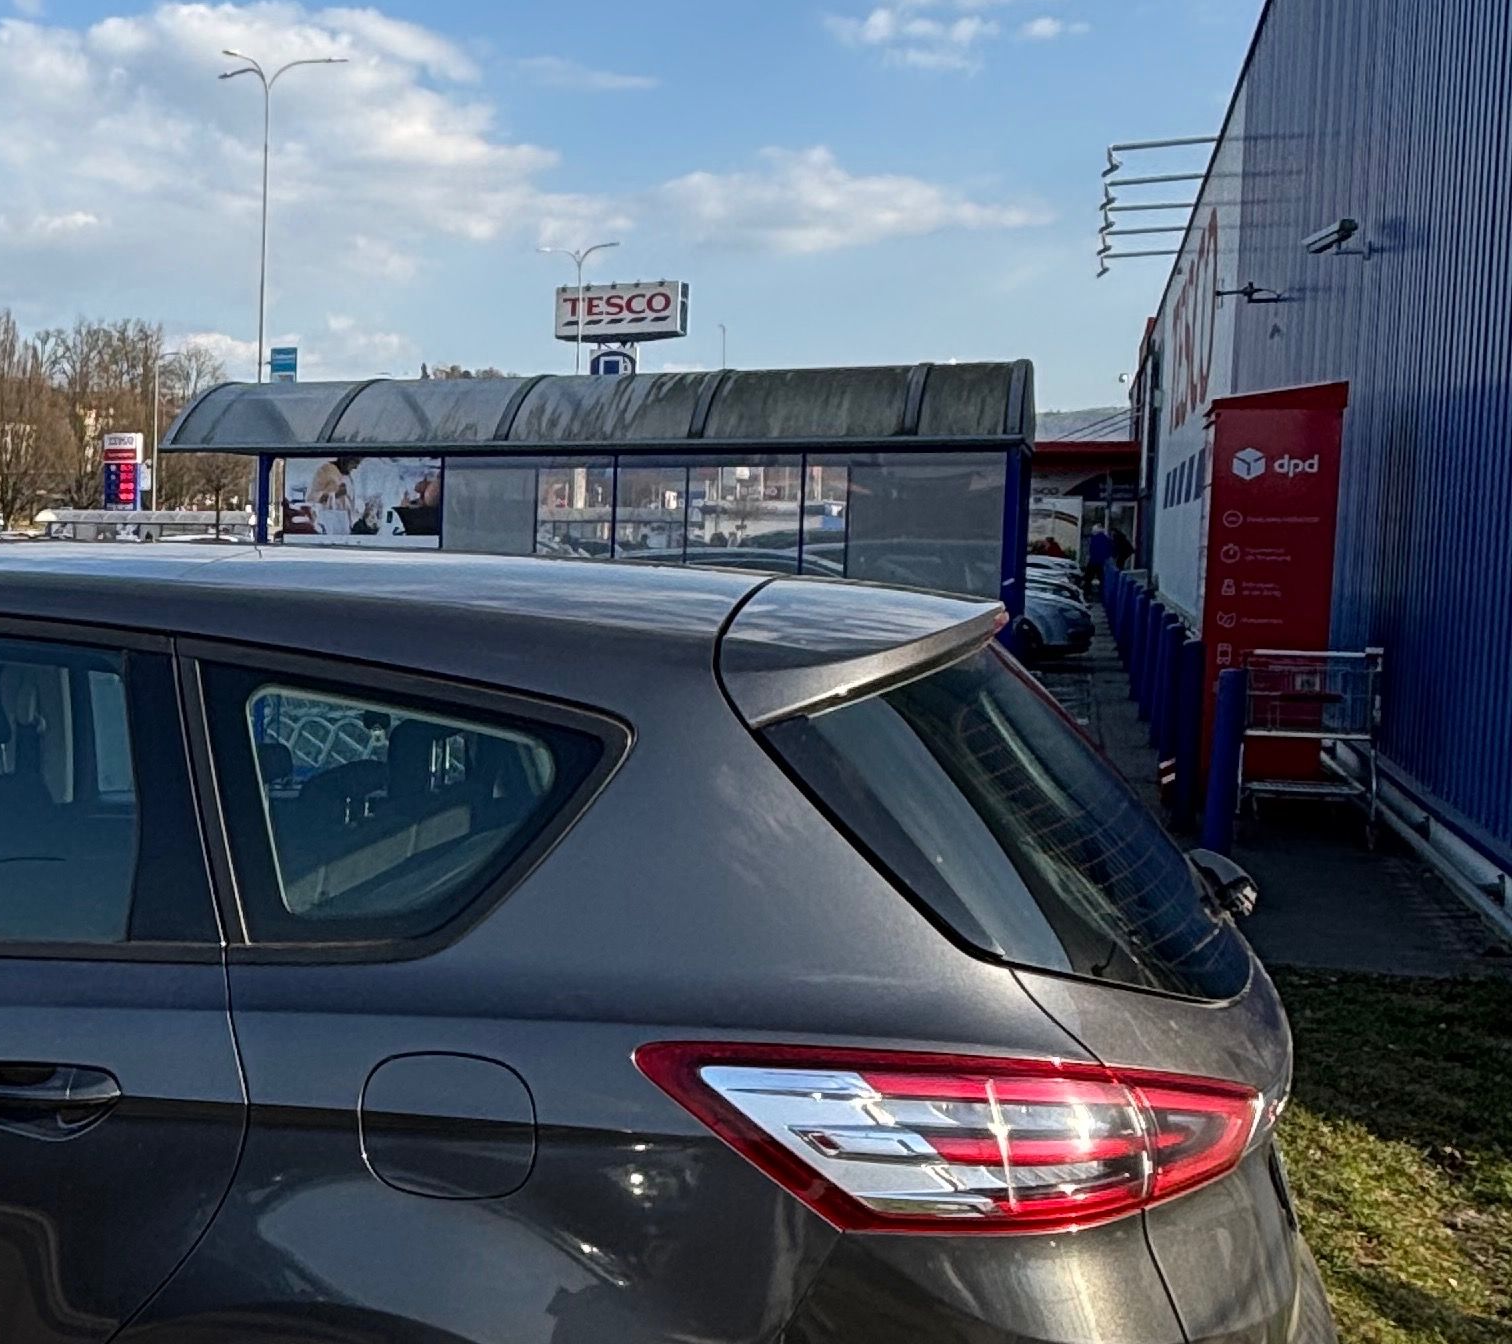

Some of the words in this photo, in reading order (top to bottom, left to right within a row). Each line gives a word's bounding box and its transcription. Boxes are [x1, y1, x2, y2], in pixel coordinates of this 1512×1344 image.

[562, 292, 672, 318] TESCO
[1169, 207, 1218, 435] TESCO
[1273, 454, 1320, 478] dpd
